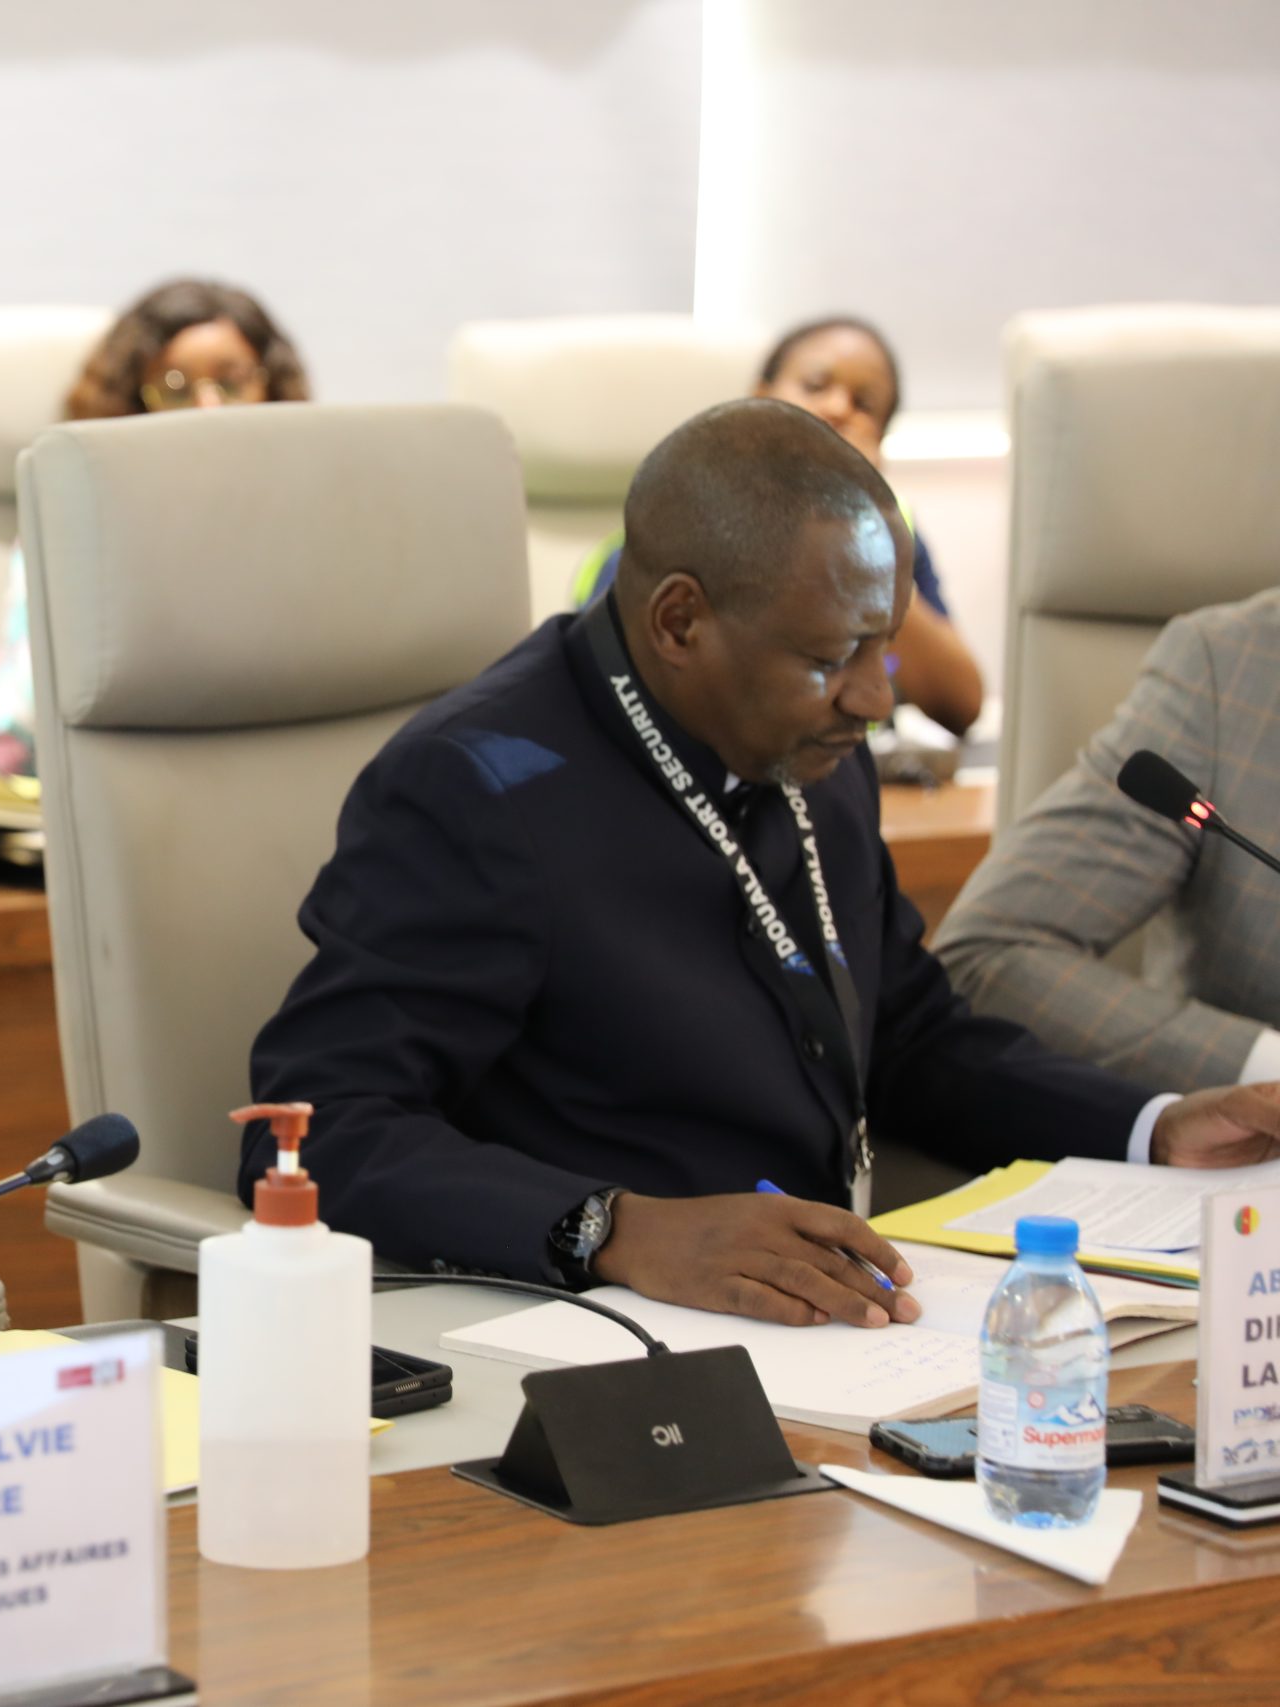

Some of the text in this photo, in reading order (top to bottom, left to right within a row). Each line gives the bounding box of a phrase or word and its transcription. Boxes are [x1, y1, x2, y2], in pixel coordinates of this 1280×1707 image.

[609, 674, 798, 959] DOUALA PORT SECURITY
[803, 835, 838, 941] DOUALA
[1245, 1314, 1280, 1342] DI
[18, 1538, 128, 1576] AFFAIRES
